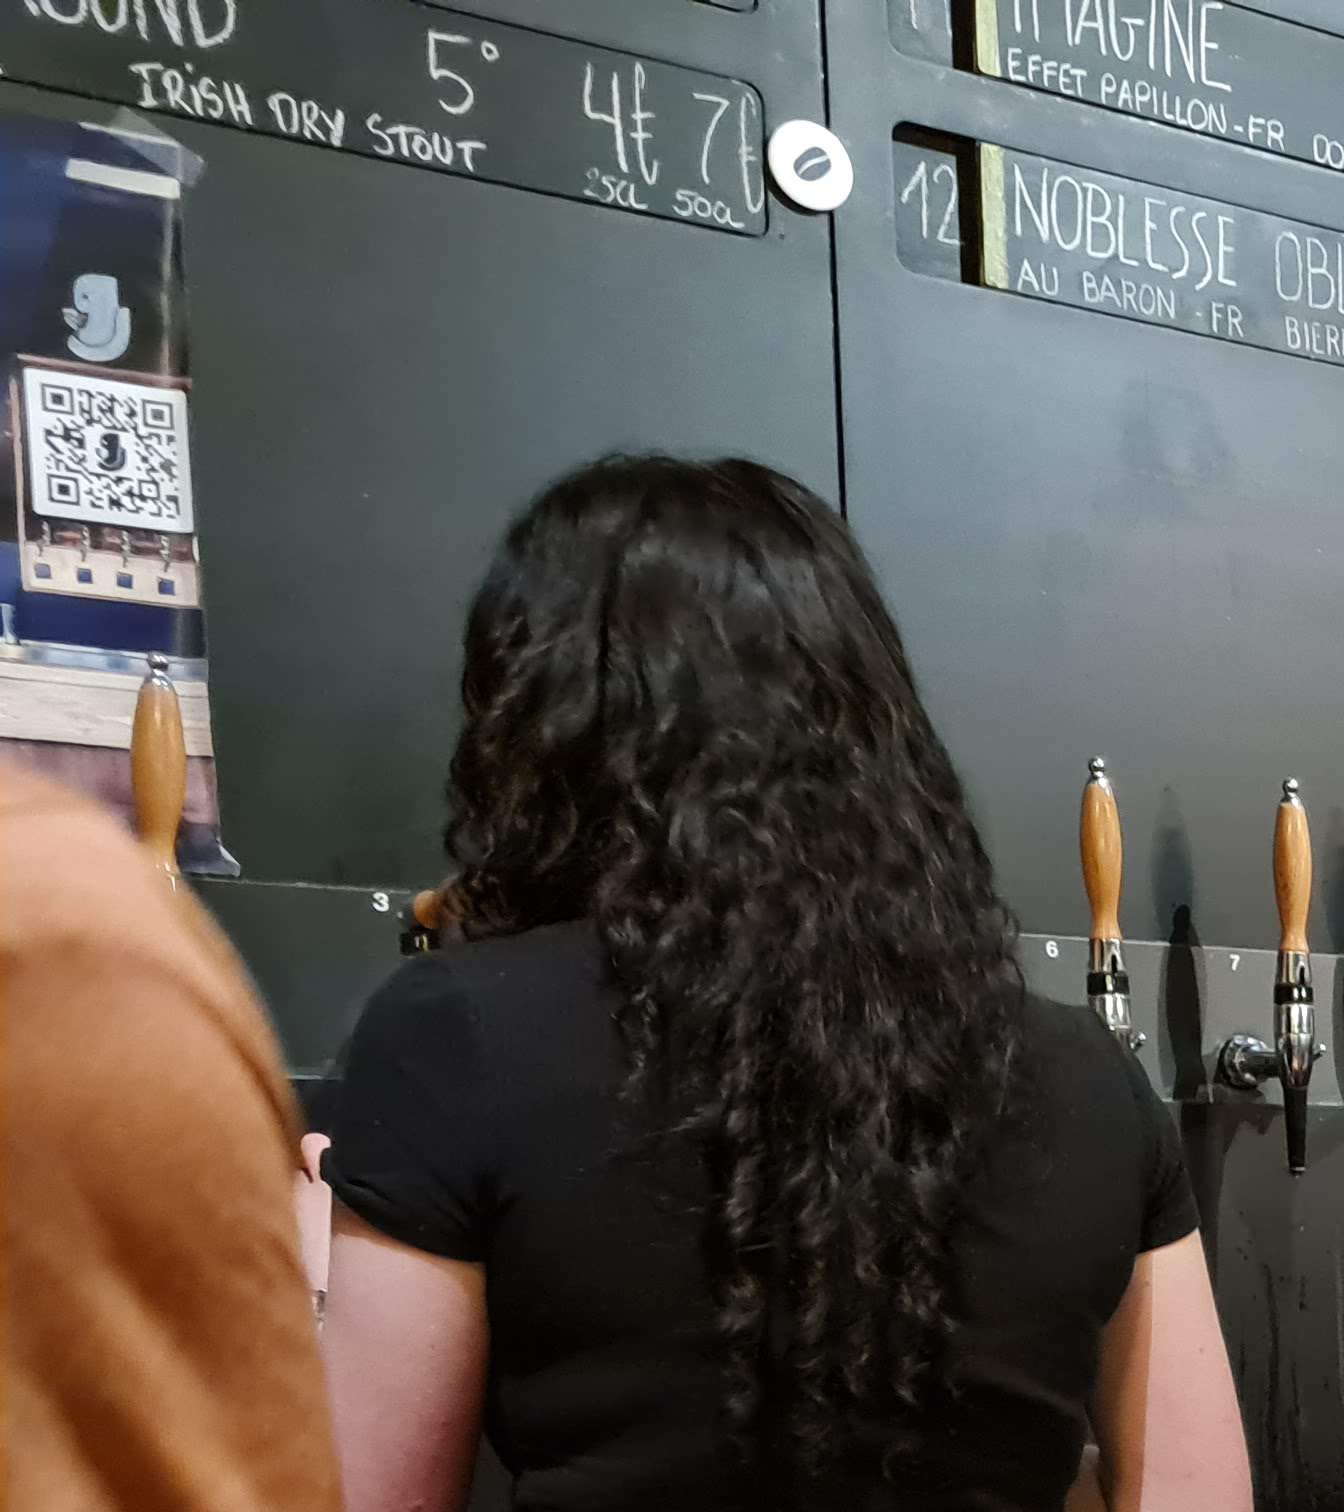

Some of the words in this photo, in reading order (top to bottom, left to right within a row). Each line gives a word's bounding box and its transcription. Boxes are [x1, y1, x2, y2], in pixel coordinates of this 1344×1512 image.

[427, 28, 501, 116] 5°
[1007, 47, 1088, 98] EFFET
[267, 92, 346, 147] DRY
[366, 111, 487, 173] STOUT
[900, 160, 964, 246] 12
[1011, 162, 1238, 291] NOBLESSE
[1016, 258, 1060, 297] AU
[1082, 270, 1176, 320] BARON
[371, 891, 390, 913] 3
[1045, 940, 1060, 959] 6
[1229, 953, 1242, 972] 7
